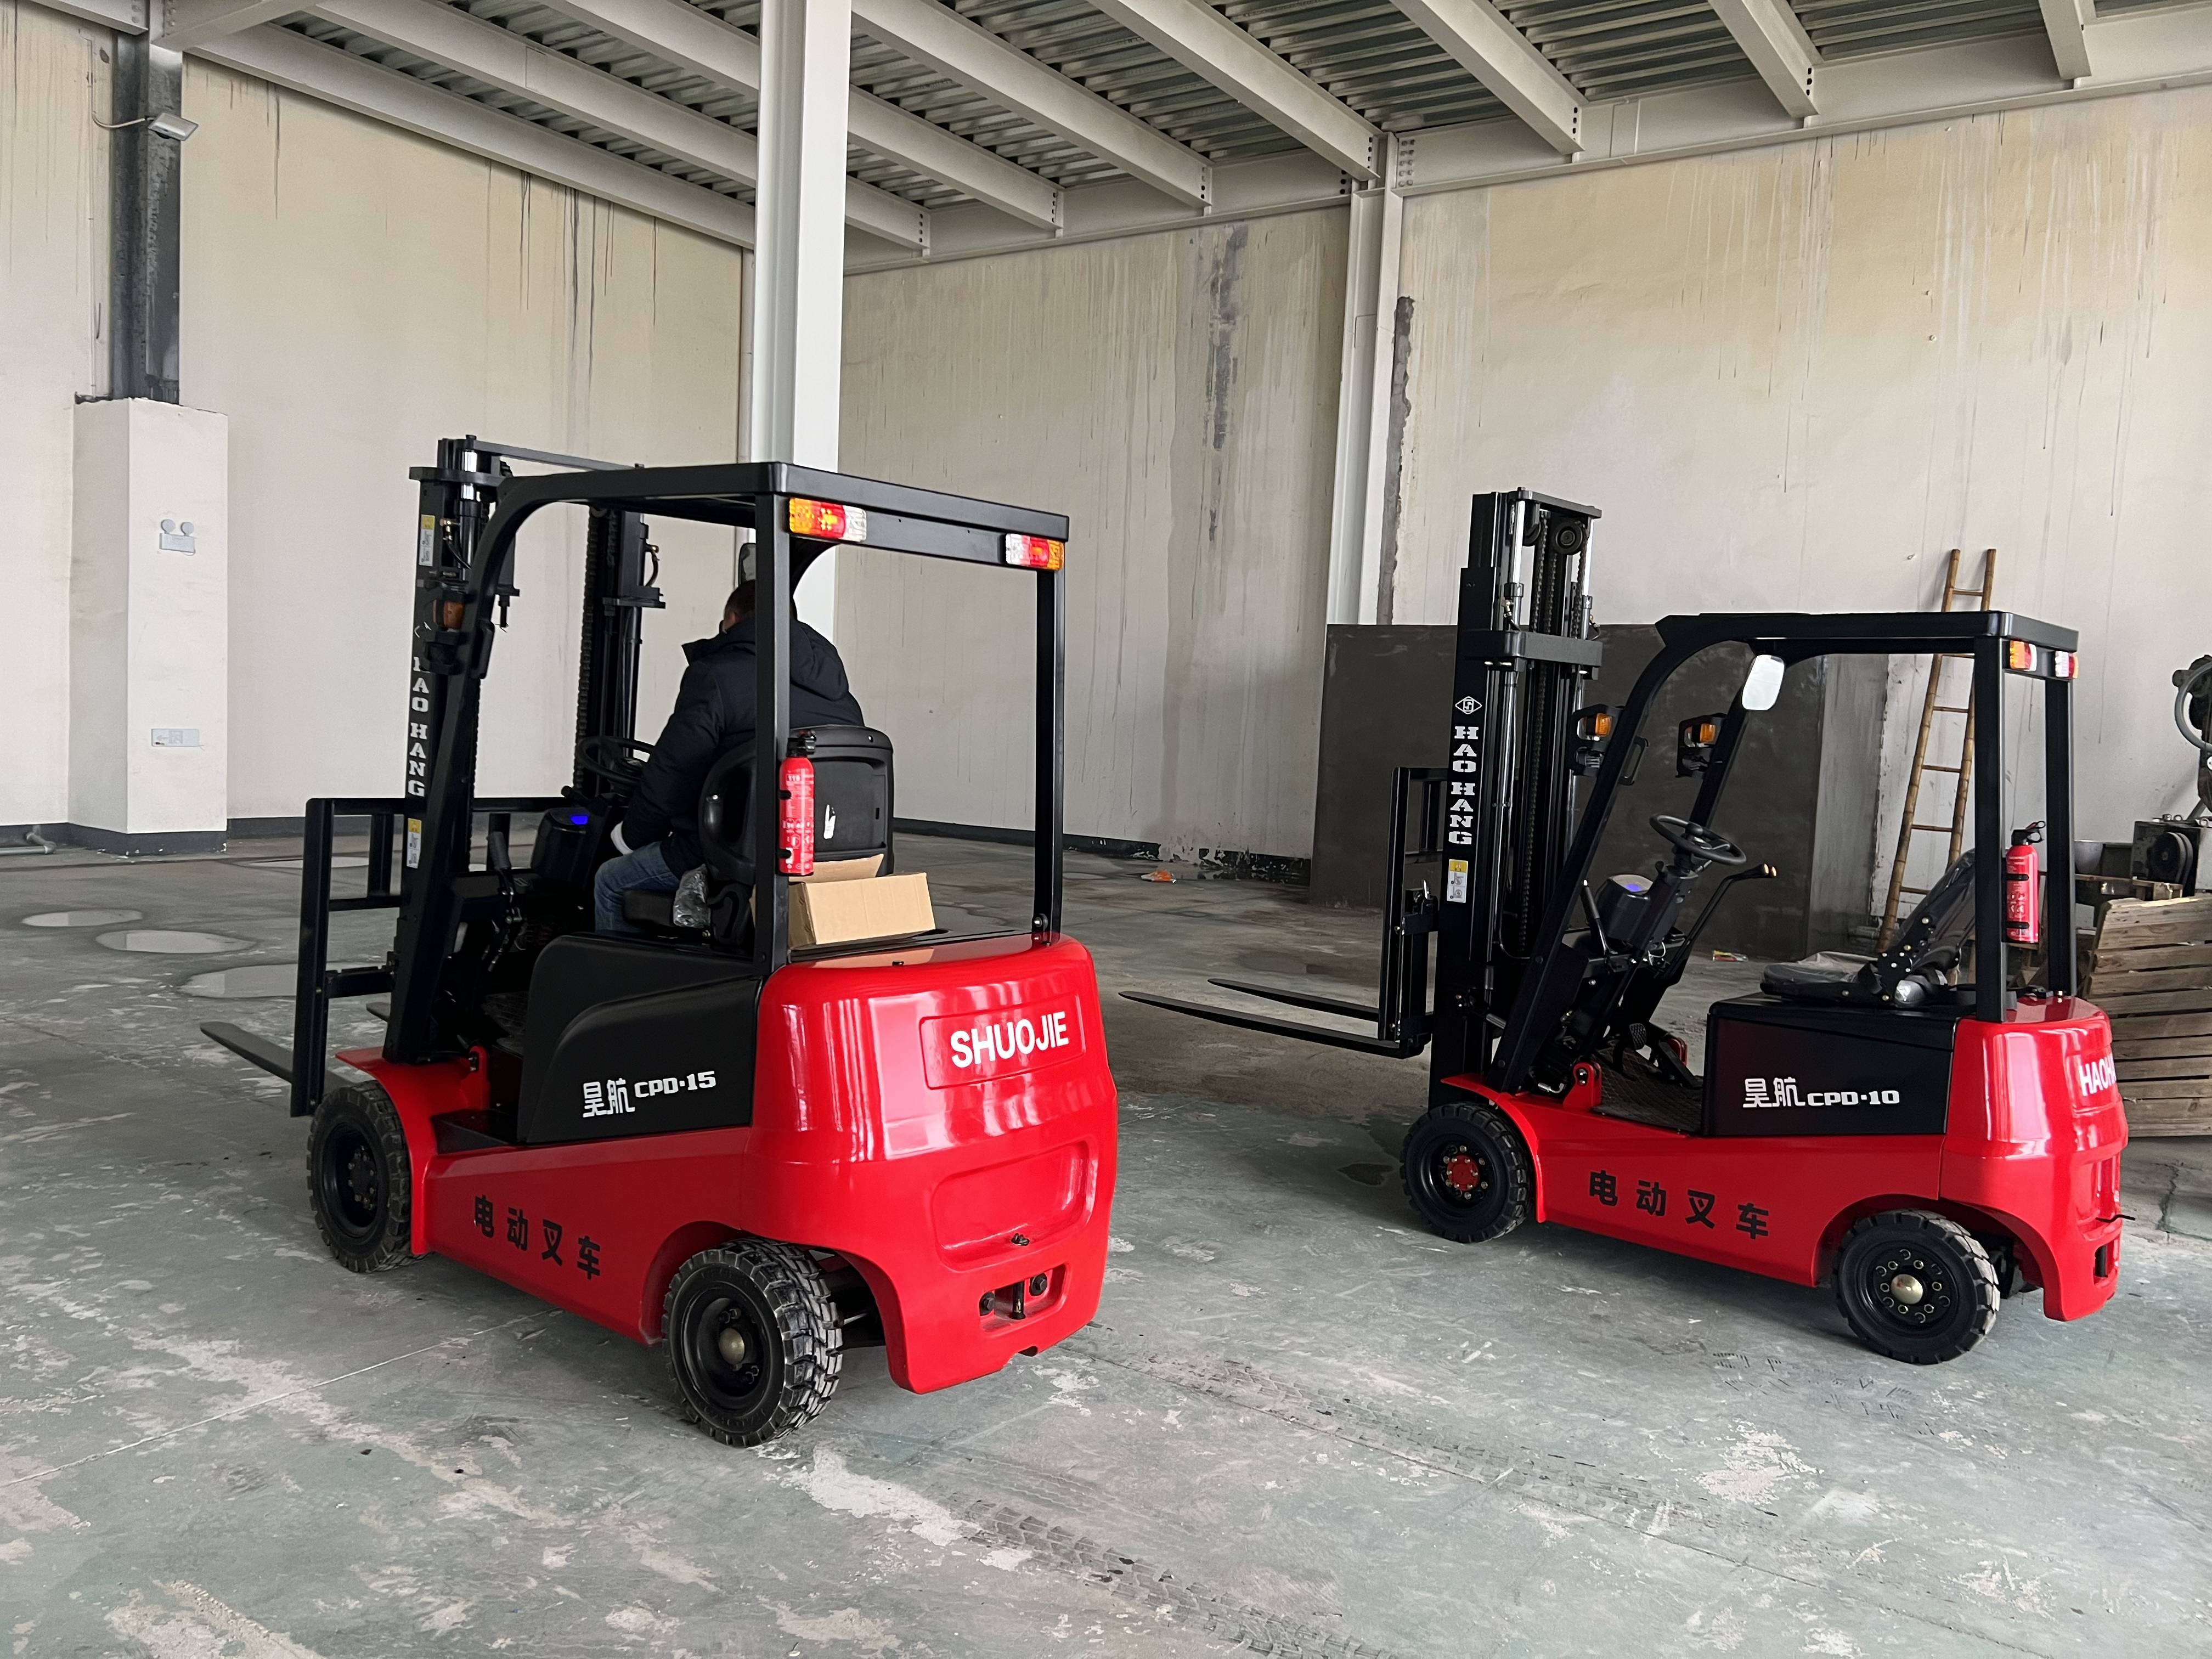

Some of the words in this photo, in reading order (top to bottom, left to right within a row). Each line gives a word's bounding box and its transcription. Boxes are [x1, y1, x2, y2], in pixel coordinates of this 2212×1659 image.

[408, 722, 427, 797] HANG
[1453, 726, 1479, 772] HAO
[1448, 782, 1476, 845] HANG
[950, 1011, 1069, 1068] SHUOJIE
[583, 1077, 635, 1118] 昊航
[1742, 1076, 1806, 1108] 昊航
[1589, 1170, 1769, 1239] 电动叉车
[475, 1194, 600, 1279] 电动叉车
